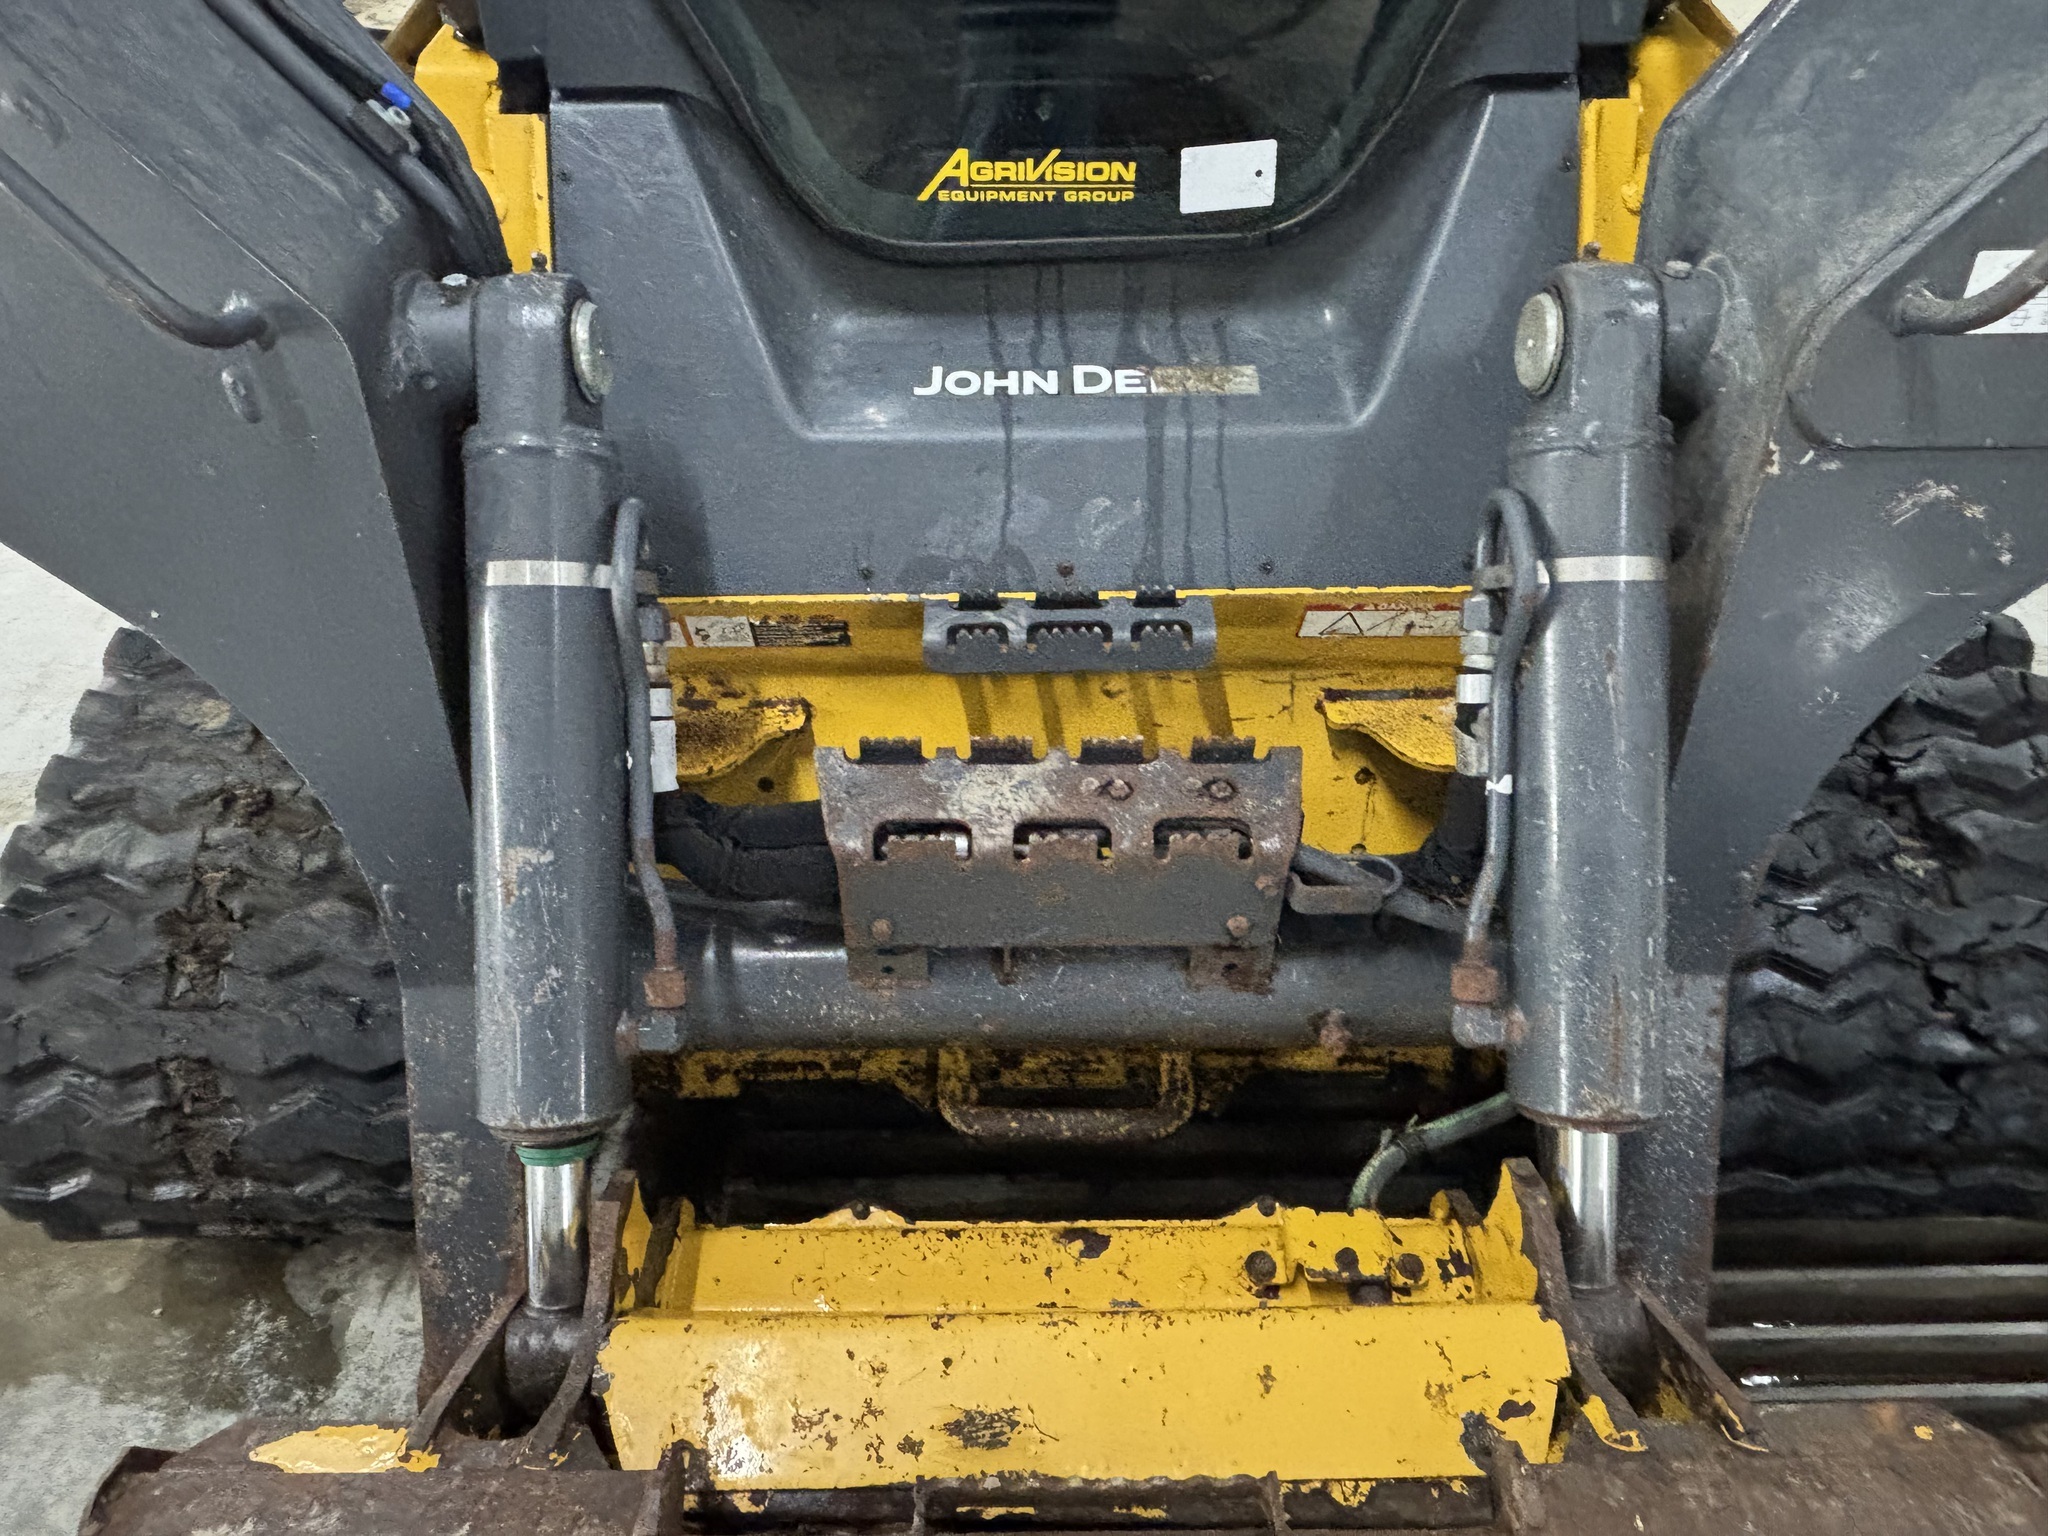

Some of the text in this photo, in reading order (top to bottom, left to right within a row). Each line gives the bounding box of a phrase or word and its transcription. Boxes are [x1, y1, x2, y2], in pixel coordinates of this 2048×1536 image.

[917, 148, 1137, 200] AGRIVISION
[937, 190, 1136, 202] EQUIPMENT GROUP
[913, 365, 1059, 396] JOHN
